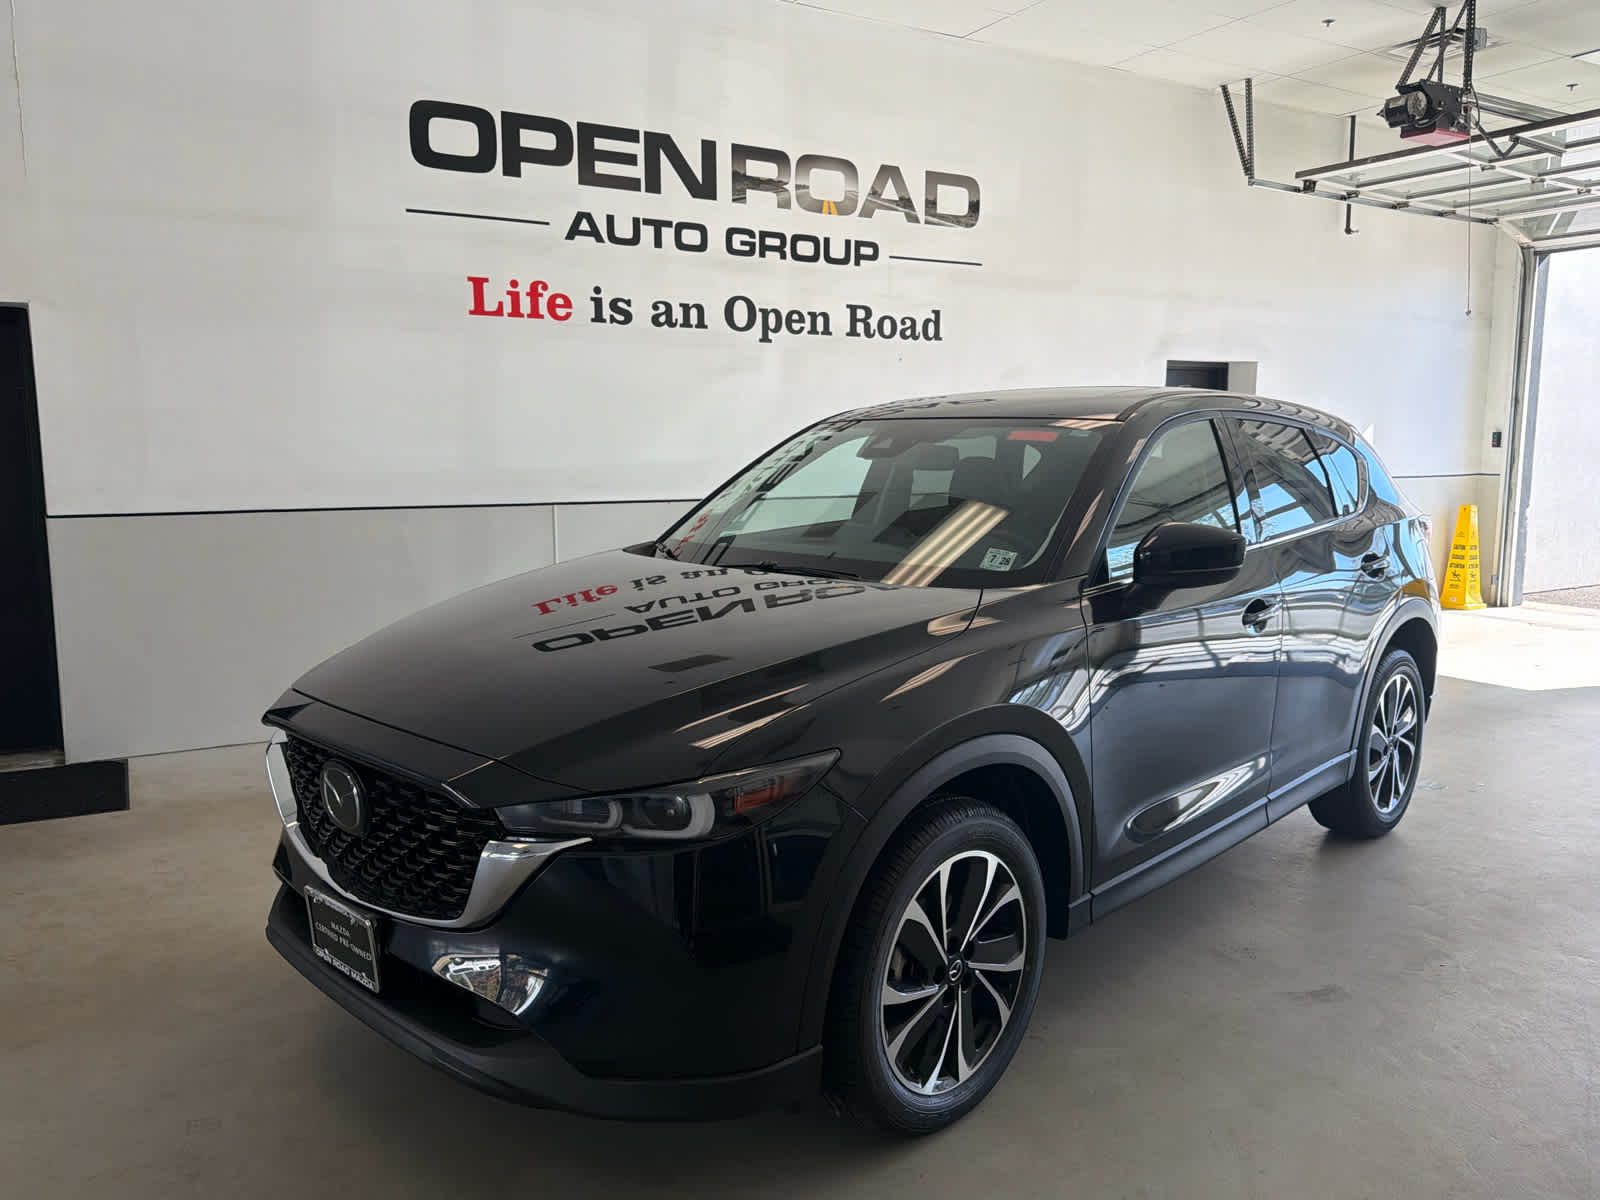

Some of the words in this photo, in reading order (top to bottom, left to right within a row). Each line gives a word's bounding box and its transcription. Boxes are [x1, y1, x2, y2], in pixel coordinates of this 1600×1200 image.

[409, 100, 717, 200] OPEN
[731, 143, 980, 228] ROAD
[565, 211, 708, 253] AUTO
[726, 227, 880, 267] GROUP
[466, 276, 573, 322] Life
[590, 286, 633, 325] is
[651, 301, 708, 330] an
[724, 296, 833, 343] Open
[846, 304, 943, 342] Road
